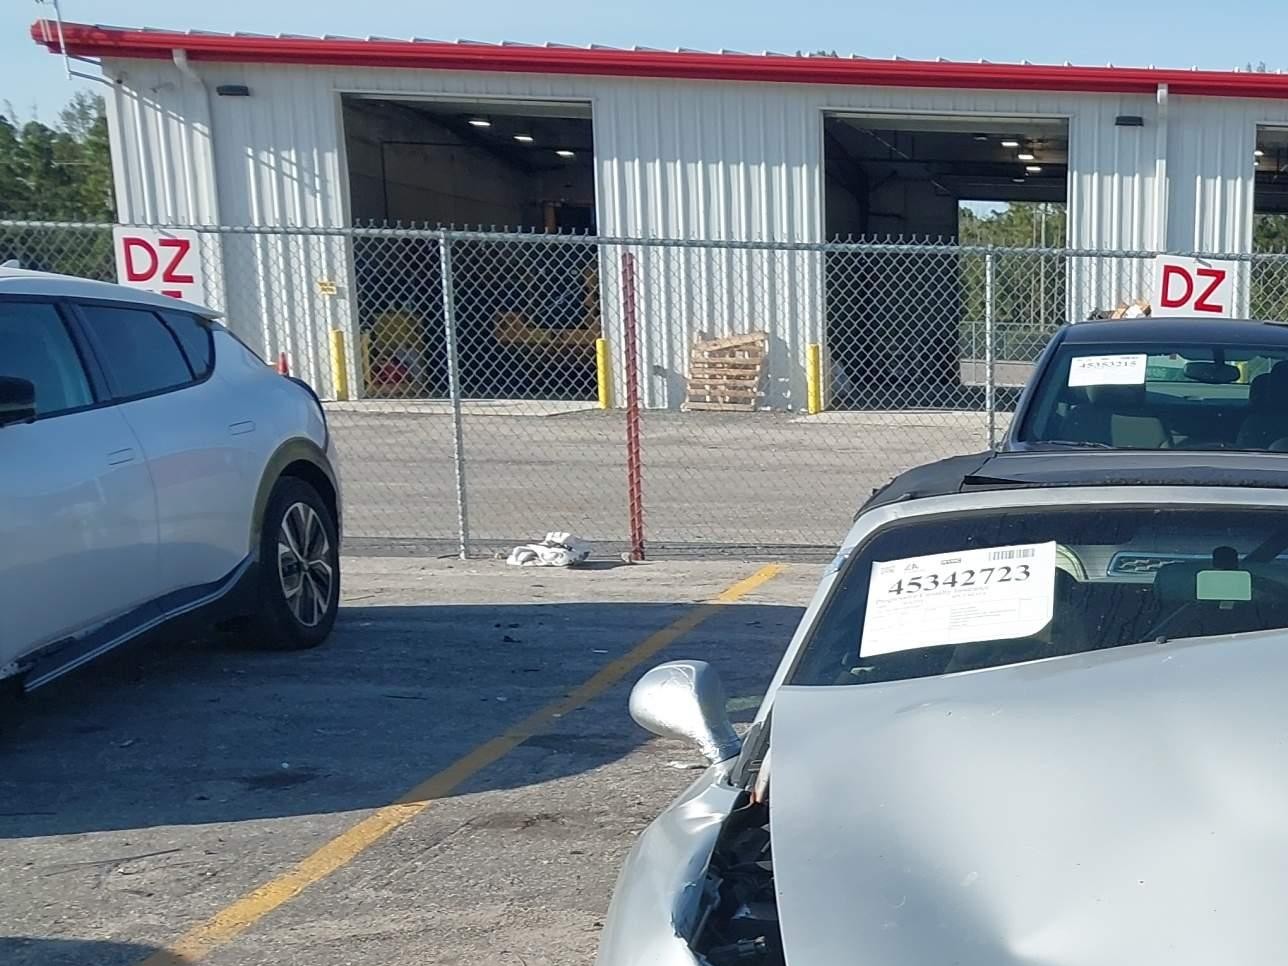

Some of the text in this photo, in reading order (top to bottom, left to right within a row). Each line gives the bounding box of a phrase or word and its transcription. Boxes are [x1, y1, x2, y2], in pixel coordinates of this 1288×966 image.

[122, 237, 195, 283] DZ
[1160, 265, 1226, 313] DZ
[888, 564, 1031, 596] 45342723
